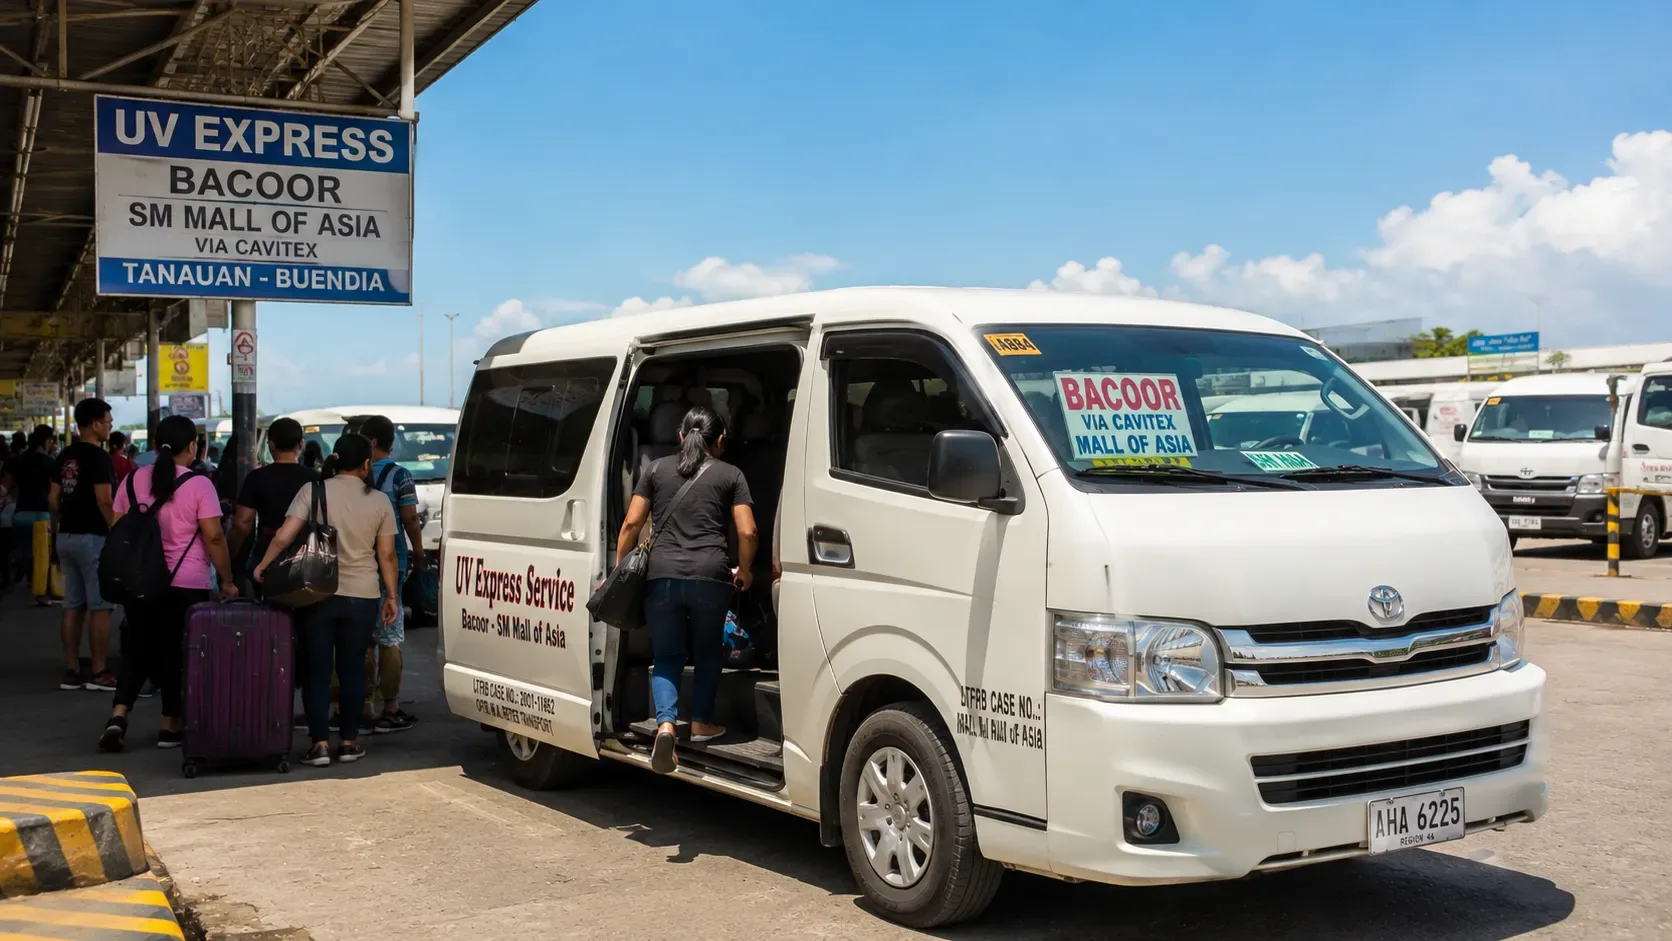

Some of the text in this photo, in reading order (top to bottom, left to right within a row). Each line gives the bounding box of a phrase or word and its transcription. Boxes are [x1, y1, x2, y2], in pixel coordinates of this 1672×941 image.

[115, 109, 394, 164] UV EXPRESS
[170, 165, 342, 204] BACOOR
[128, 202, 381, 238] SM MALL OF ASIA
[195, 237, 318, 259] VIA CAVITEX
[122, 262, 251, 287] TANAUAN
[275, 268, 385, 292] BUENDIA
[1061, 377, 1182, 411] BACOOR
[1081, 414, 1177, 431] VIA CAVITEX
[1075, 435, 1194, 455] MALL OF ASIA
[456, 555, 575, 613] UV Express Service
[462, 608, 489, 633] Bacoor
[497, 613, 510, 638] SM
[512, 616, 531, 642] Mall
[533, 620, 543, 645] of
[545, 622, 566, 649] Asia
[990, 691, 1016, 717] CASE
[1376, 797, 1460, 838] AHA 6225
